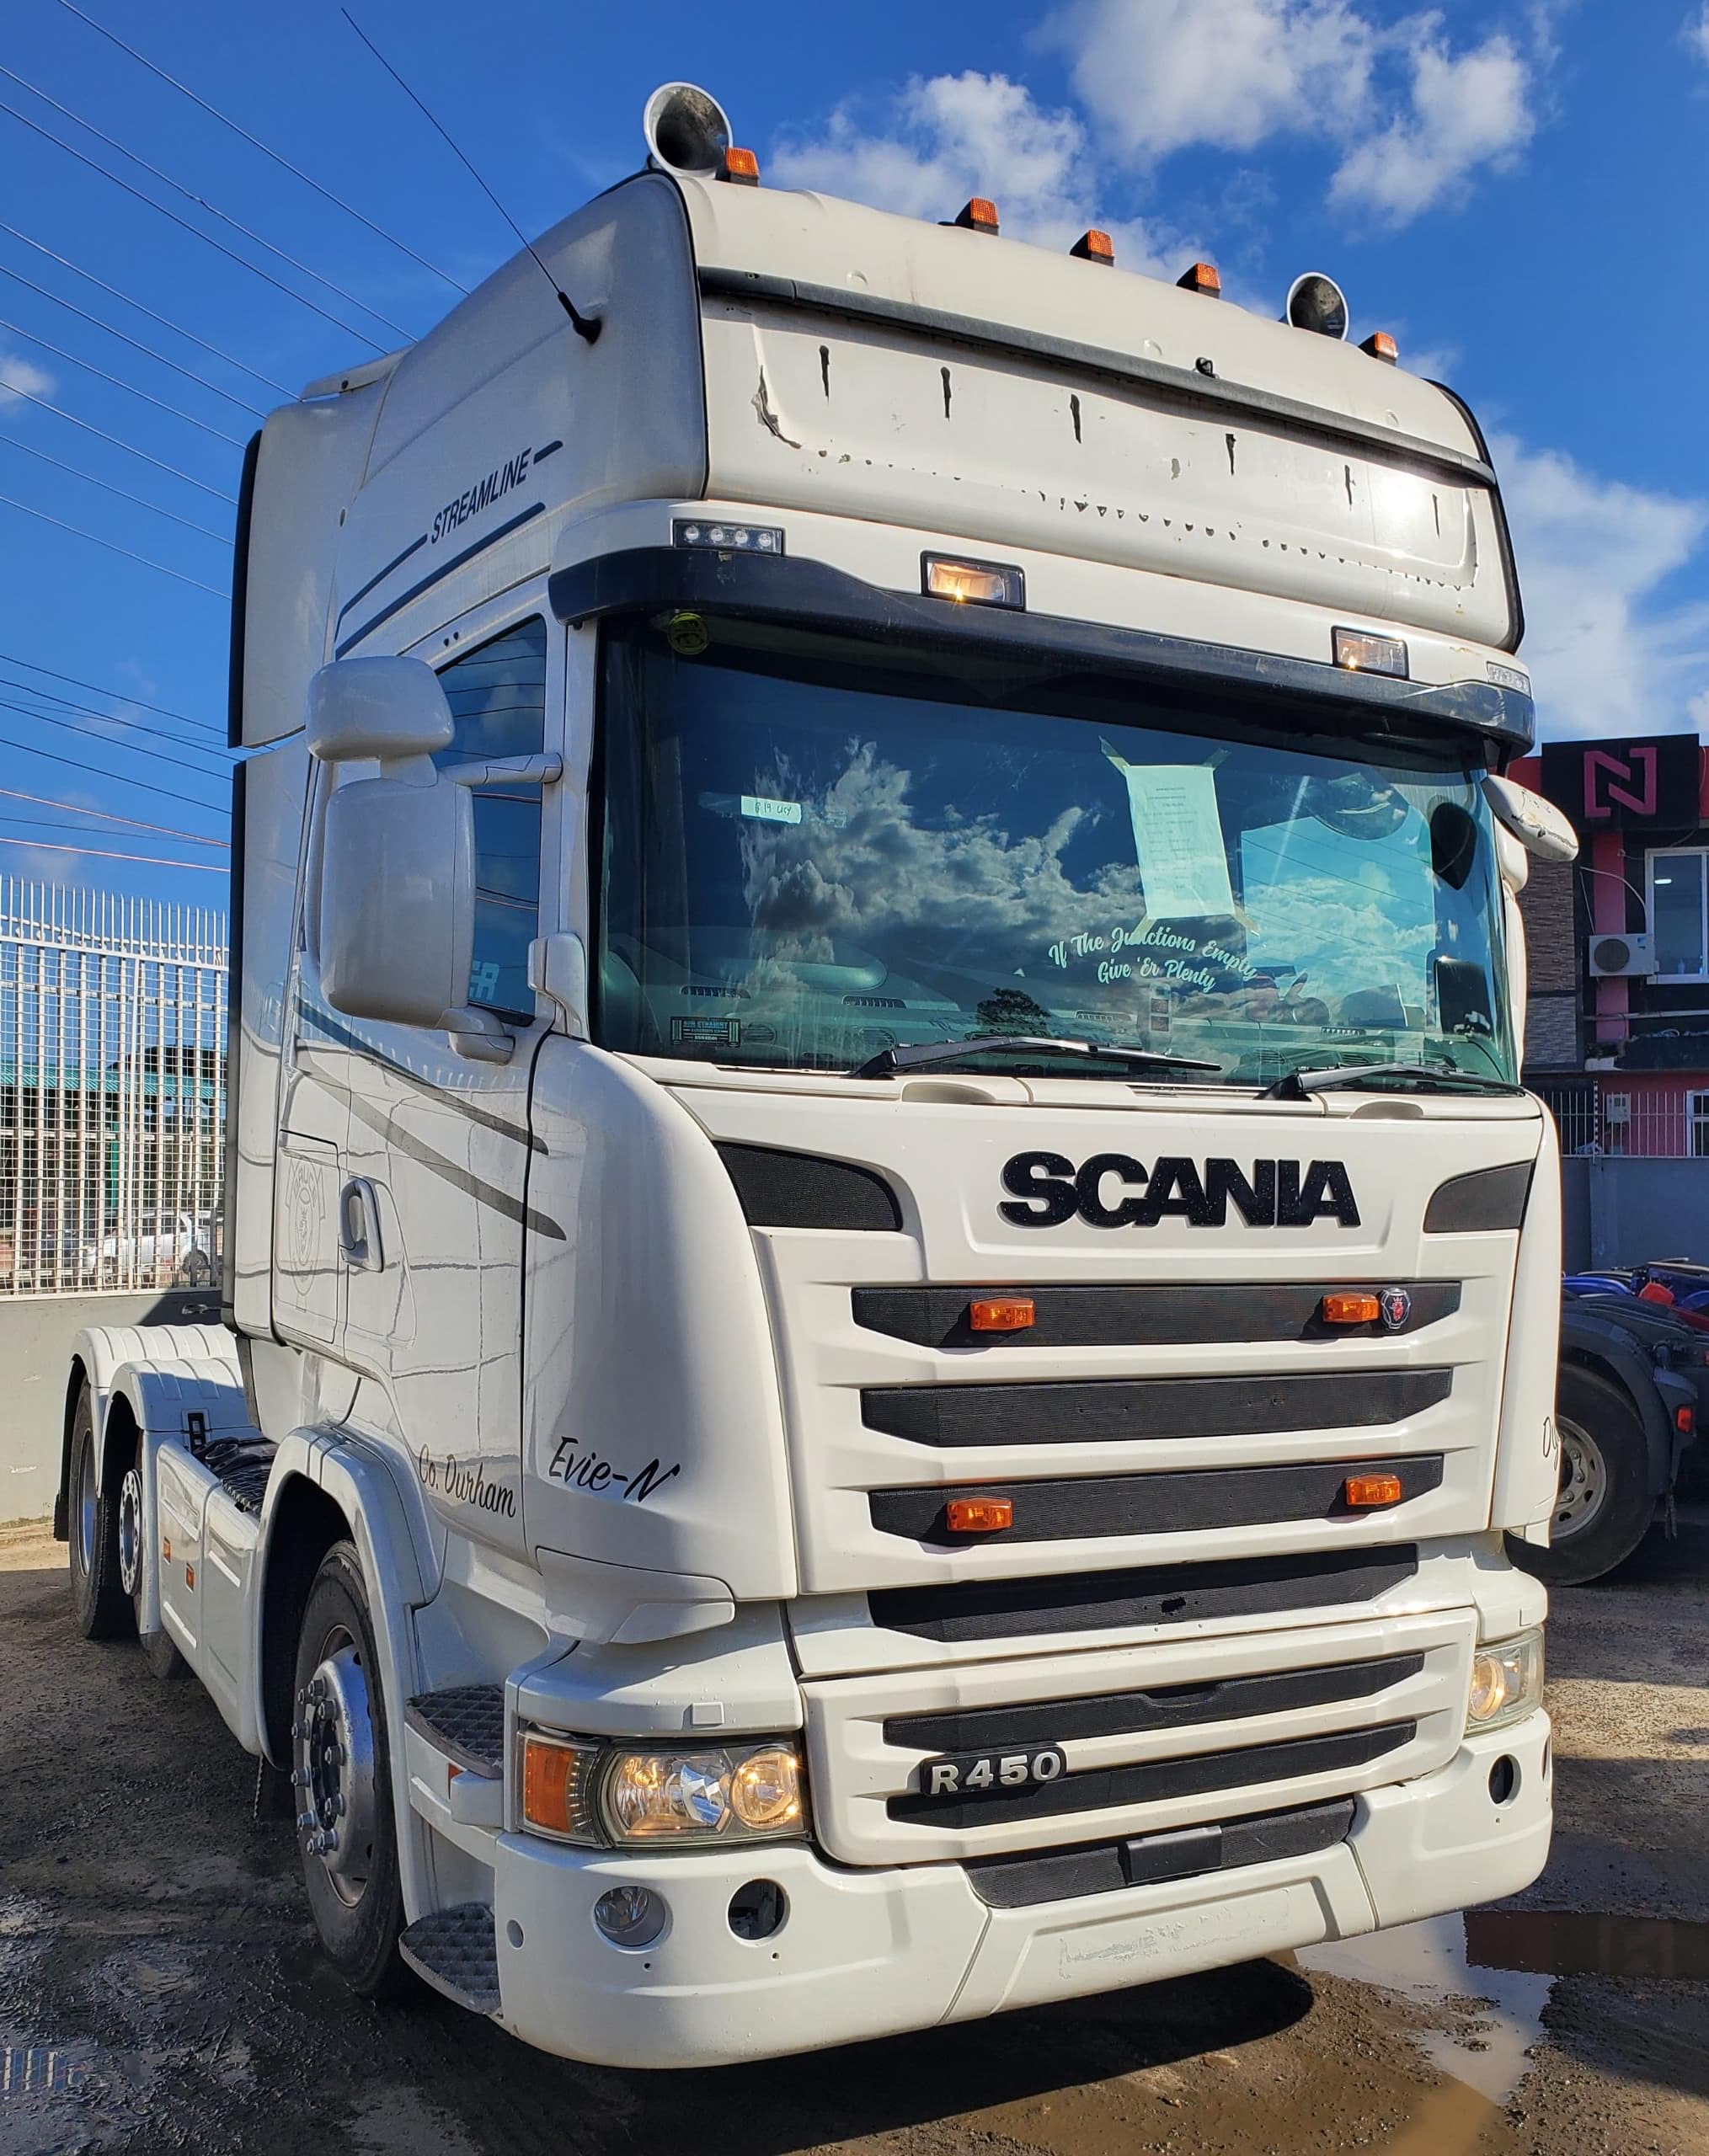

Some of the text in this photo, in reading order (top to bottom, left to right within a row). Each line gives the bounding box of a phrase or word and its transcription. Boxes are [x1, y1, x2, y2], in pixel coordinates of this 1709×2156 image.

[431, 446, 532, 544] STREAMLINE
[1048, 941, 1067, 969] If
[1071, 932, 1104, 958] The
[1202, 940, 1258, 982] Empty
[1097, 958, 1132, 985] Give
[1164, 959, 1217, 993] Plenty
[996, 1150, 1361, 1228] SCANIA
[419, 1443, 516, 1518] Co. Durham
[548, 1435, 681, 1503] Evie-N
